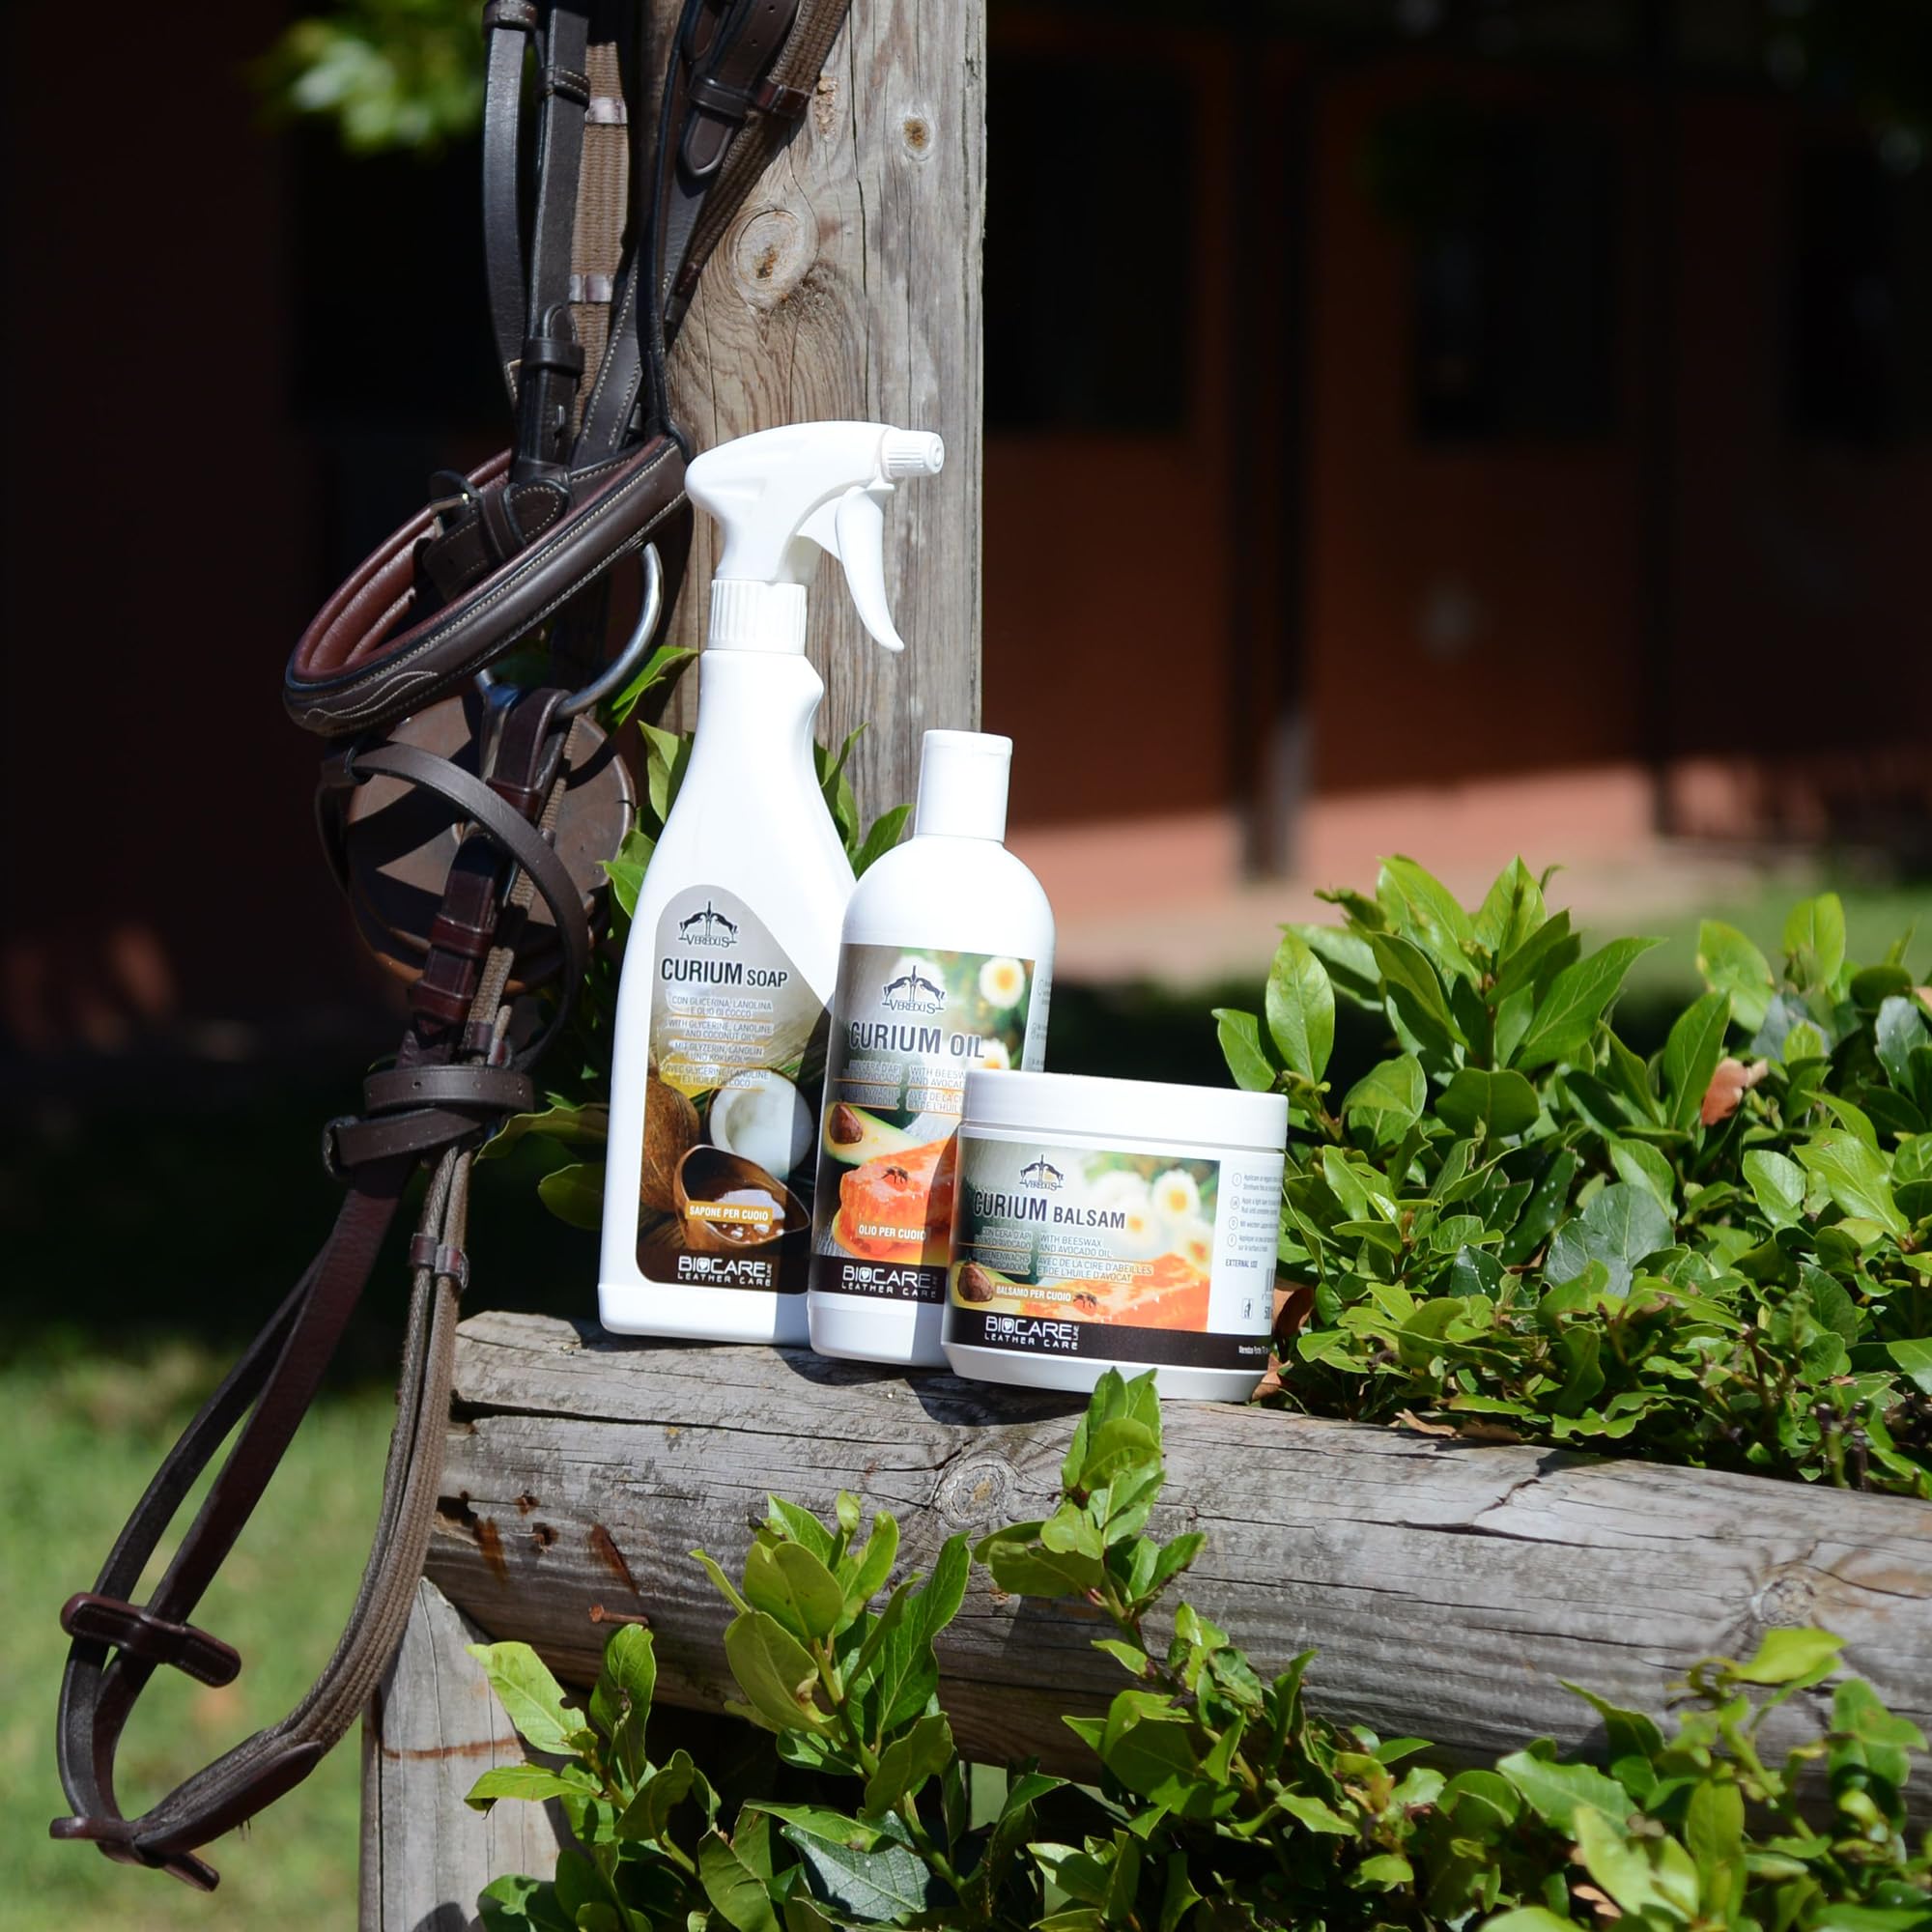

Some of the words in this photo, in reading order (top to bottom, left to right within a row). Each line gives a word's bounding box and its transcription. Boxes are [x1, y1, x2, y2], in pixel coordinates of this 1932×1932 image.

[661, 957, 743, 985] CURIUM
[747, 969, 788, 987] SOAP
[671, 996, 689, 1005] CON
[733, 1000, 772, 1010] LANOLINA
[725, 1009, 752, 1018] COCCO
[668, 1018, 688, 1028] WITH
[685, 1029, 701, 1037] AND
[851, 1021, 942, 1055] CURIUM
[950, 1034, 985, 1059] OIL
[910, 1065, 932, 1075] WITH
[909, 1075, 928, 1085] AND
[689, 1205, 722, 1217] SAPONE
[723, 1208, 740, 1218] PER
[741, 1209, 769, 1221] CUOIO
[974, 1191, 1047, 1222] CURIUM
[1054, 1207, 1125, 1229] BALSAM
[858, 1224, 877, 1236] OLIO
[878, 1226, 896, 1237] PER
[897, 1229, 926, 1241] CUOIO
[1040, 1235, 1060, 1243] WITH
[1063, 1236, 1102, 1247] BEESWAX
[1039, 1244, 1057, 1253] AND
[1059, 1245, 1097, 1256] AVOCADO
[678, 1256, 766, 1278] BIOCARE
[1038, 1257, 1059, 1266] AVEC
[1060, 1259, 1071, 1267] DE
[1072, 1260, 1083, 1268] LA
[1084, 1262, 1103, 1270] CIRE
[677, 1271, 732, 1284] LEATHER
[739, 1276, 772, 1287] CARE
[842, 1265, 930, 1289] BIOCARE
[841, 1281, 895, 1294] LEATHER
[901, 1287, 936, 1298] CARE
[996, 1286, 1030, 1297] BALSAMO
[1030, 1289, 1045, 1300] PER
[1046, 1290, 1072, 1302] CUOIO
[985, 1315, 1072, 1340] BIOCARE
[984, 1332, 1036, 1346] LEATHER
[1043, 1339, 1078, 1350] CARE
